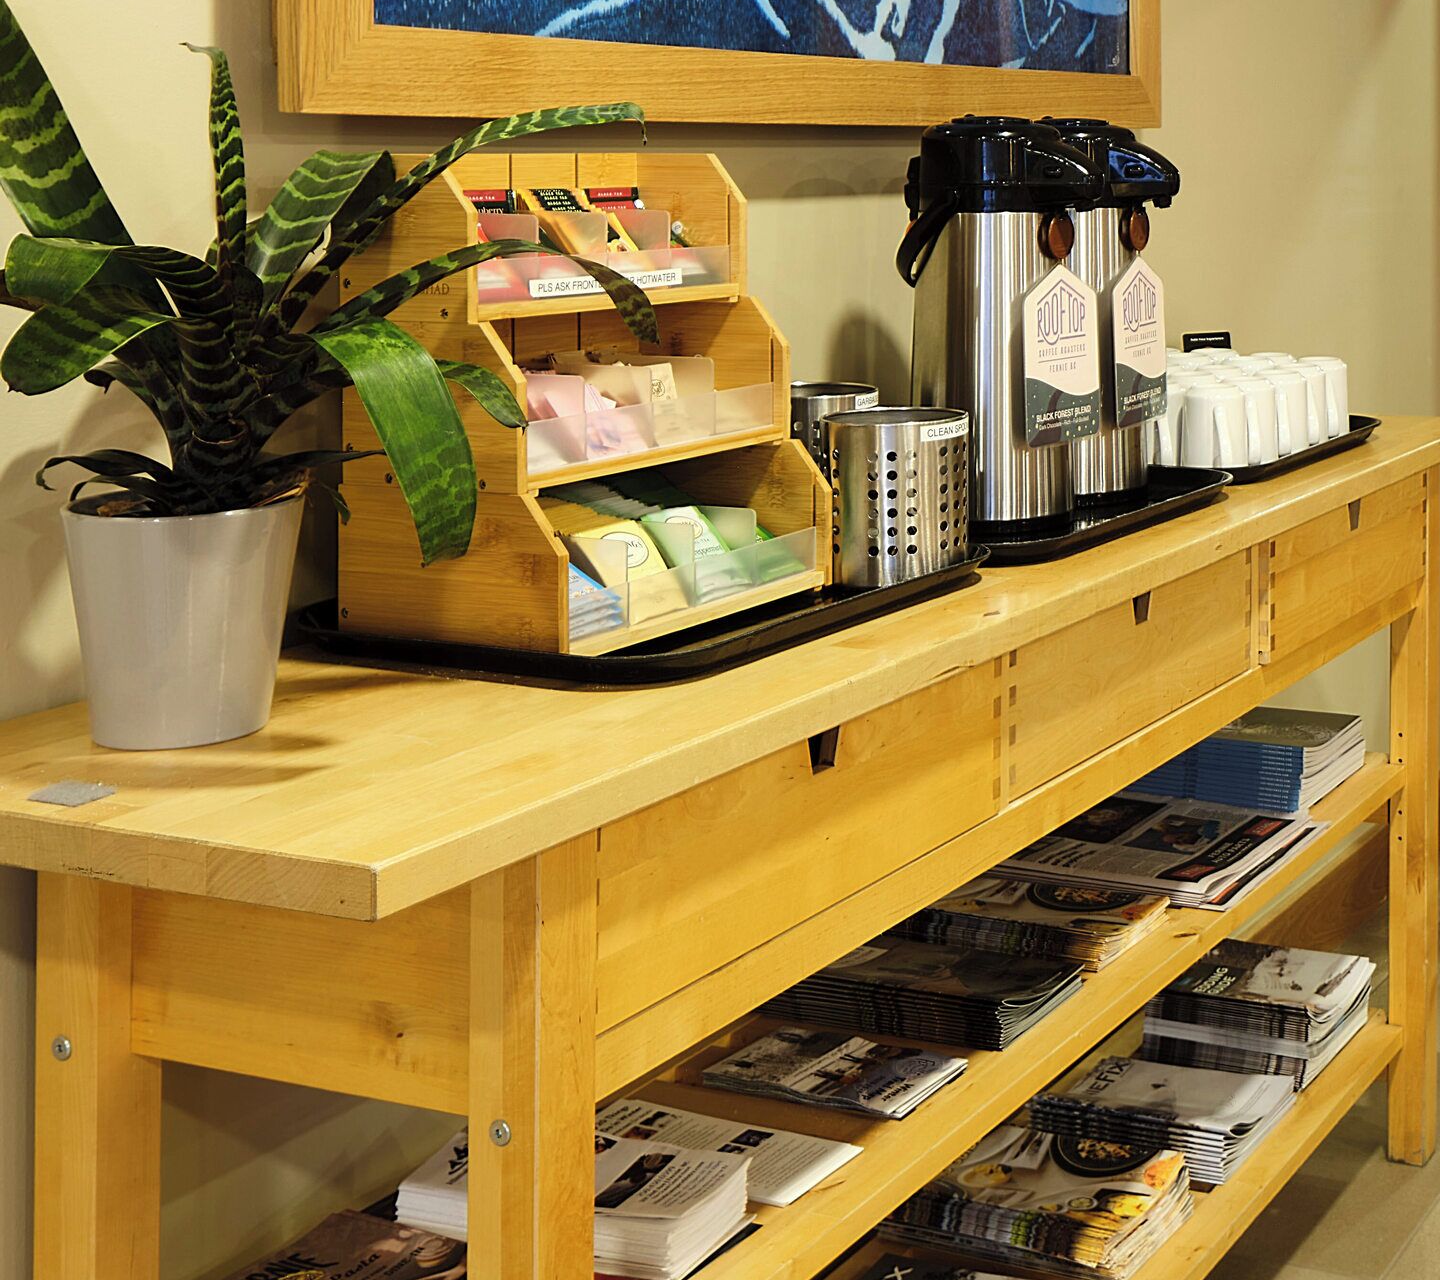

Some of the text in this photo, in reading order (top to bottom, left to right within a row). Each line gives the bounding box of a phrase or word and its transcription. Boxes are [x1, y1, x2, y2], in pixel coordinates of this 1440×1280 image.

[538, 283, 553, 293] PLS
[555, 281, 571, 292] ASK
[637, 272, 676, 285] HOTWATER
[1123, 277, 1157, 333] ROOFTOP
[1037, 286, 1086, 345] ROOFTOP
[857, 395, 878, 406] GARBA
[1036, 404, 1091, 422] BLACK FOREST BLEND
[927, 425, 954, 438] CLEAN
[881, 1083, 914, 1102] Winter
